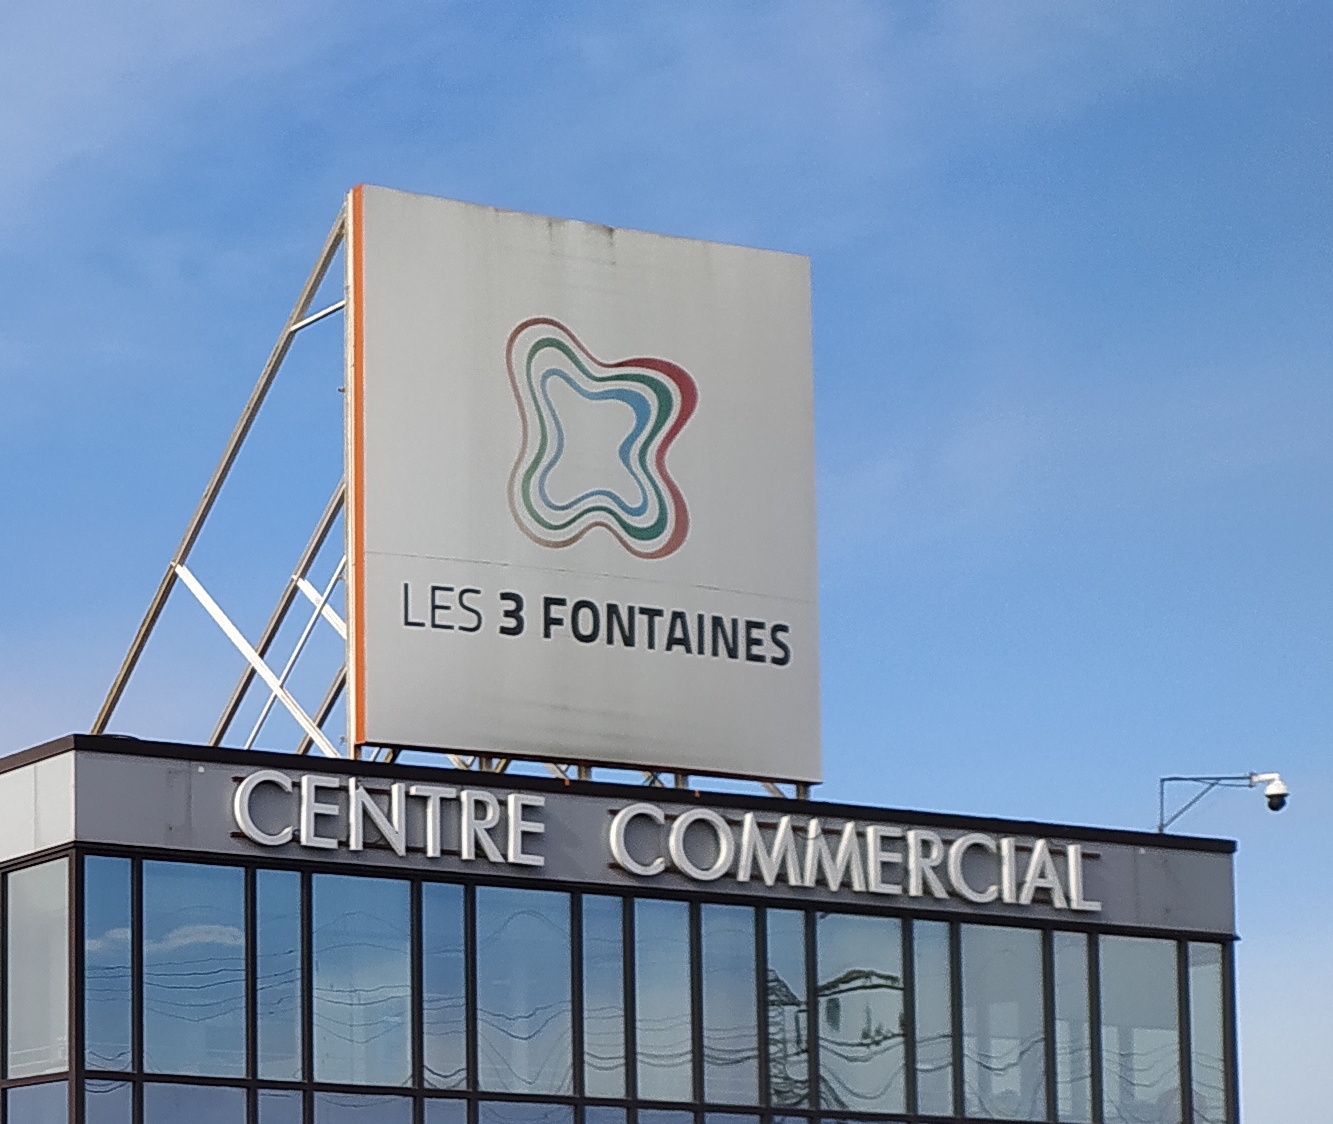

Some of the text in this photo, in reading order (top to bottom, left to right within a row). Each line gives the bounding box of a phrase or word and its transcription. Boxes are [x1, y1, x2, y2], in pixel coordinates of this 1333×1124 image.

[402, 582, 792, 667] LES 3 FONTAINES
[233, 769, 1103, 912] CENTRE COMMERCIAL
